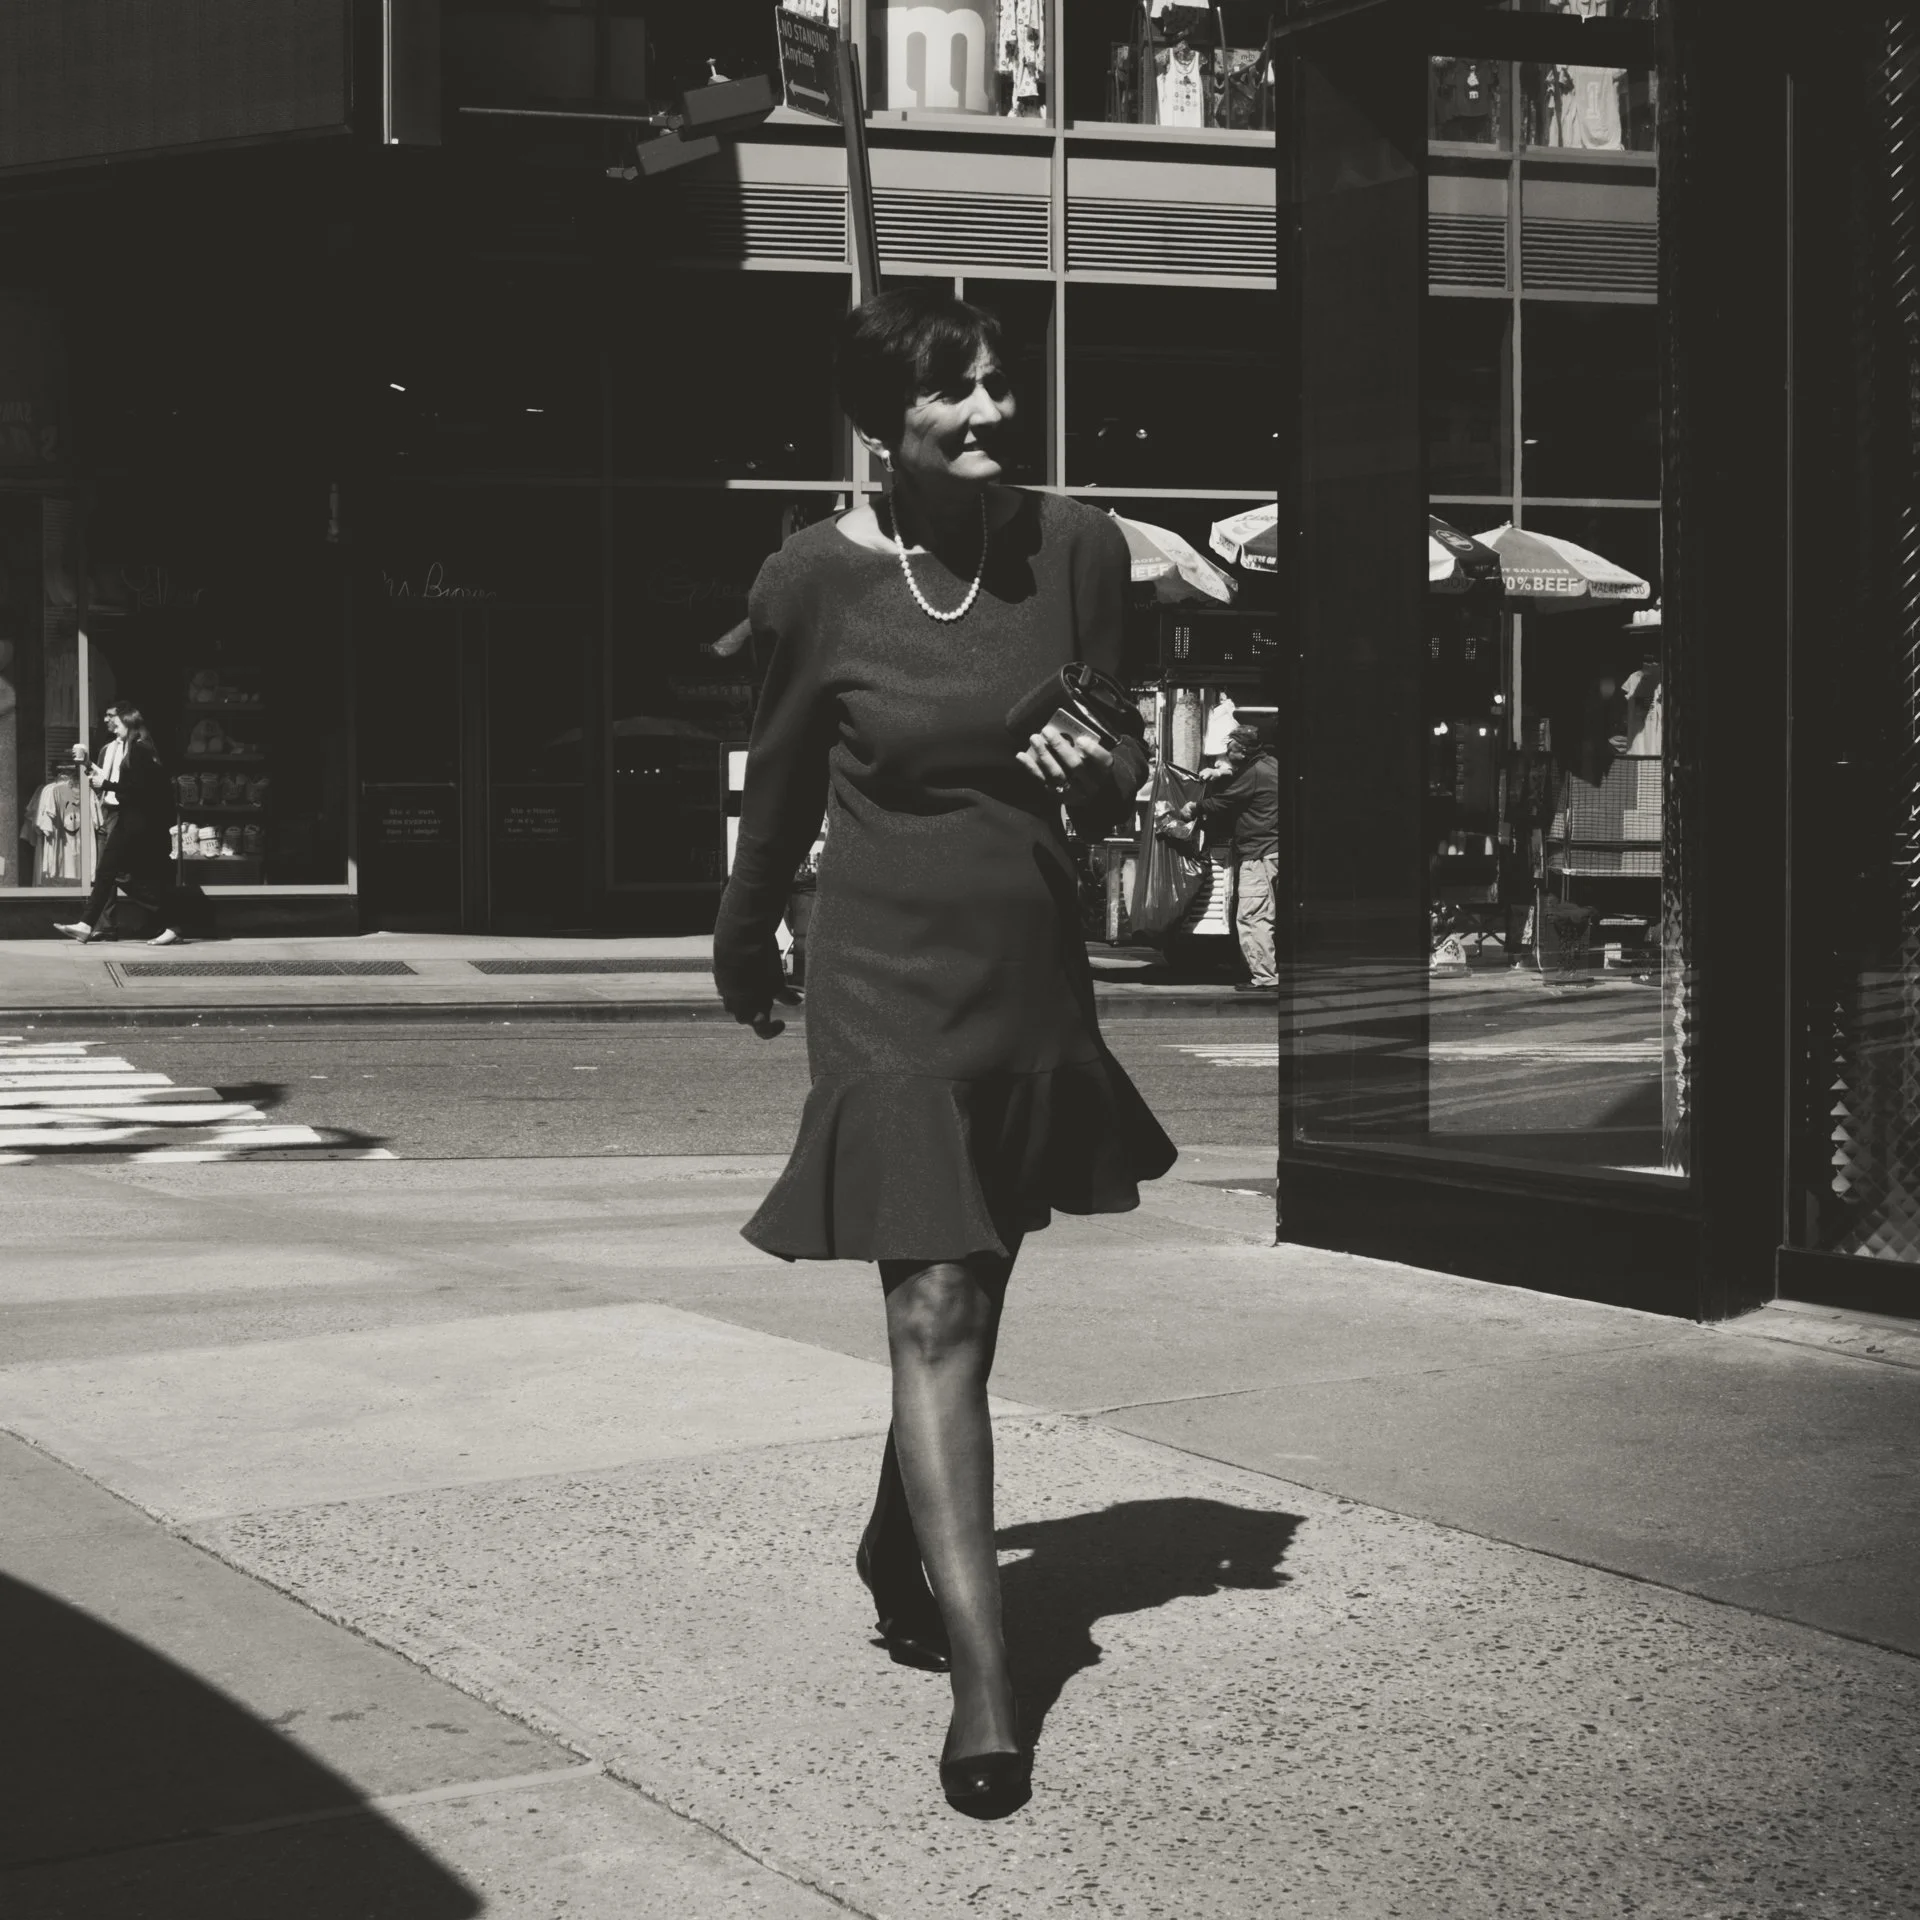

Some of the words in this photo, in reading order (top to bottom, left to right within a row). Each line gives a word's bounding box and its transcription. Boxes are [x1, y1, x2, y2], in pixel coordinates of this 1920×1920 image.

[781, 19, 793, 39] NO
[794, 24, 830, 53] STANDING
[785, 42, 815, 68] Anytime
[872, 6, 988, 113] m
[1131, 556, 1162, 564] AGES
[1502, 577, 1531, 591] 0%
[1533, 577, 1579, 592] BEEF
